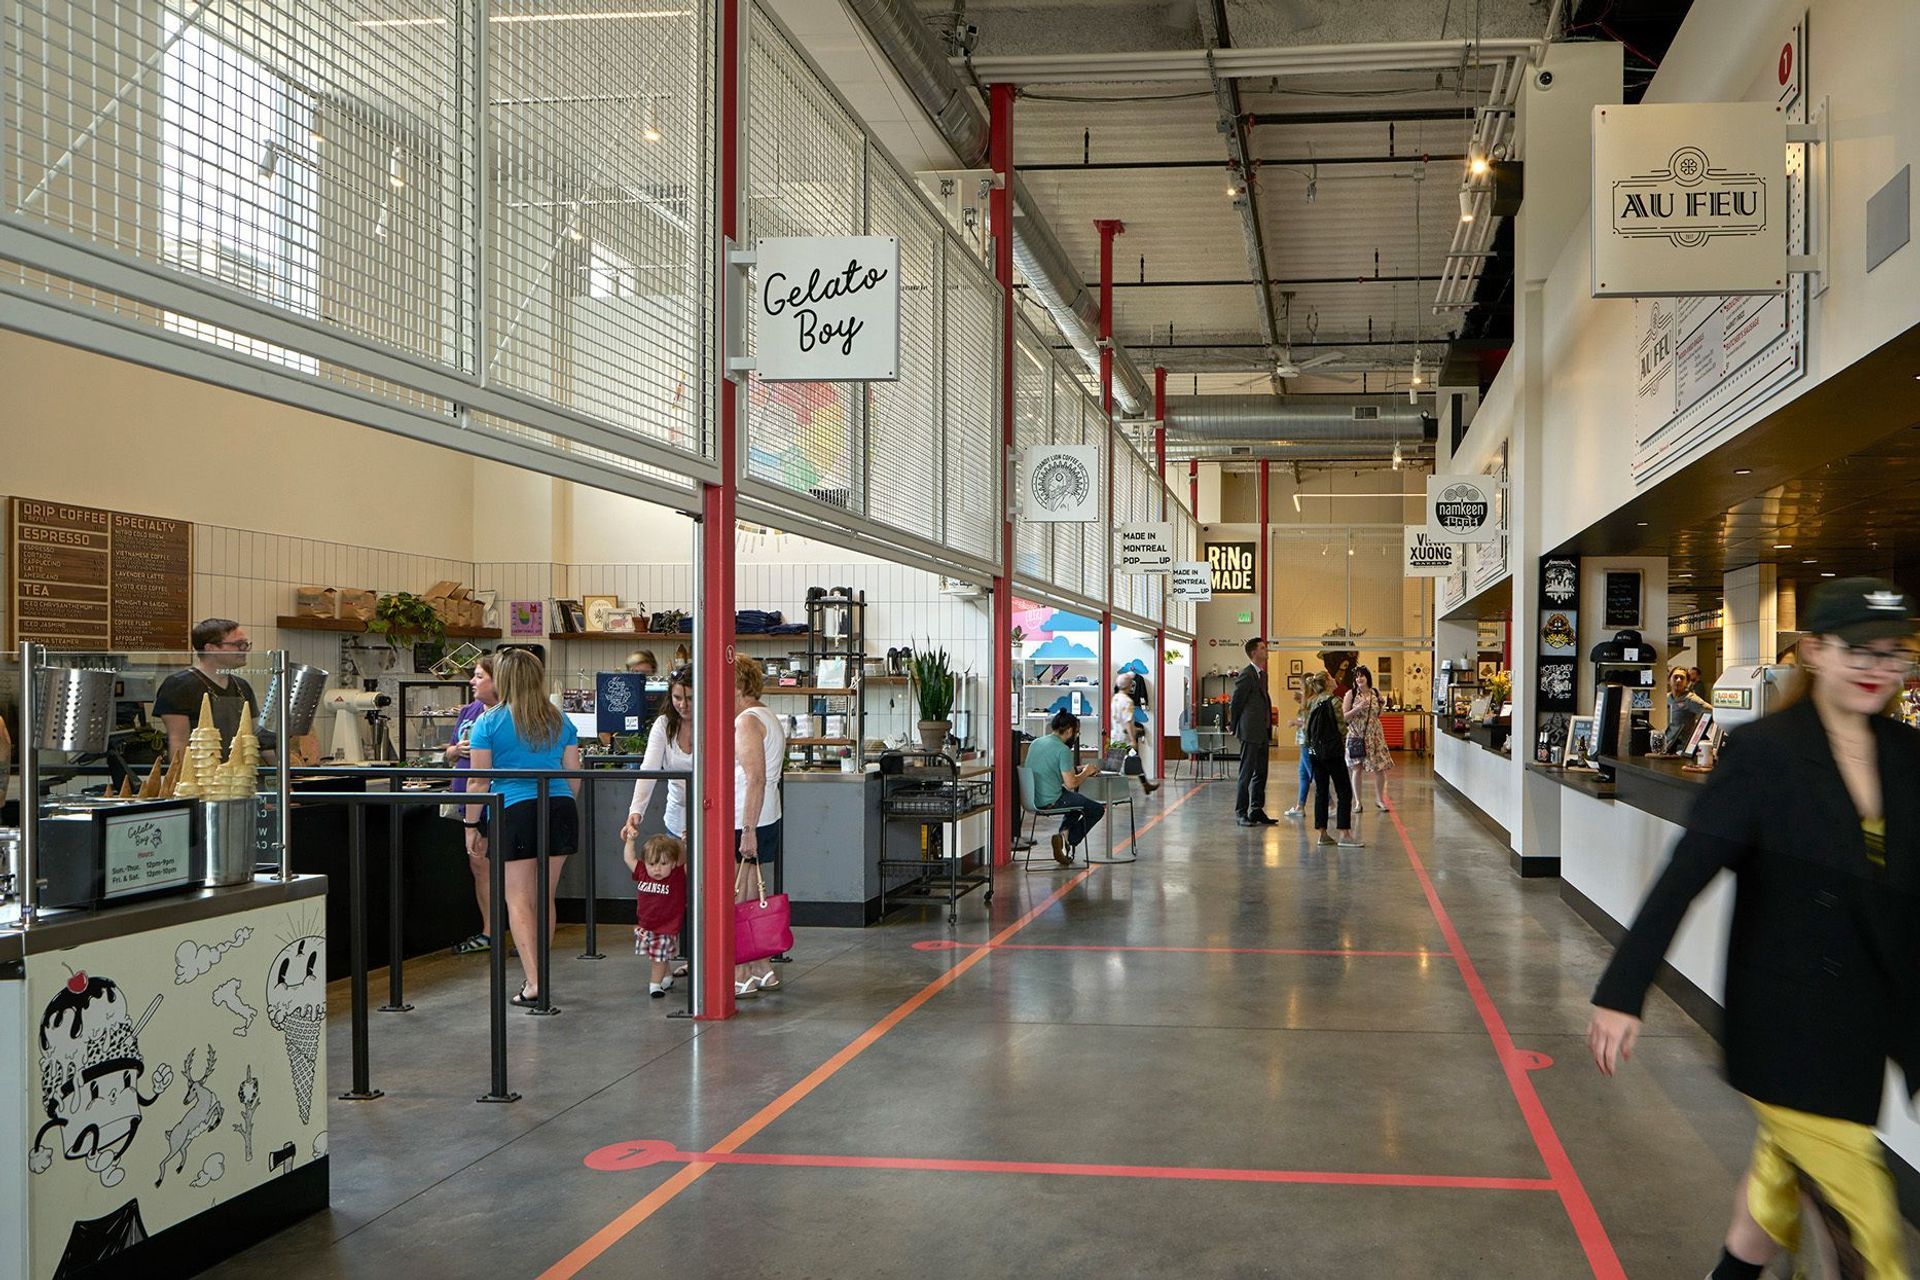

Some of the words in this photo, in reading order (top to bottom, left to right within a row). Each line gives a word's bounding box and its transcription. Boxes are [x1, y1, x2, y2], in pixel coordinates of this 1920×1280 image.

[1783, 51, 1788, 74] 1
[1621, 192, 1675, 218] AU
[1685, 191, 1758, 216] FEU
[764, 259, 888, 316] Gelato
[793, 309, 864, 355] Boy
[1062, 454, 1079, 465] COFFEE
[23, 503, 55, 518] DRIP
[59, 508, 106, 524] COFFEE
[1439, 501, 1484, 515] namkeen
[115, 515, 176, 533] SPECIALTY
[23, 528, 90, 545] ESPRESSO
[1123, 532, 1146, 540] MADE
[1147, 532, 1156, 540] IN
[1208, 546, 1252, 571] RiNo
[1410, 546, 1452, 560] XUONG
[23, 583, 50, 596] TEA
[1210, 571, 1252, 590] MADE
[127, 822, 155, 839] Gelato
